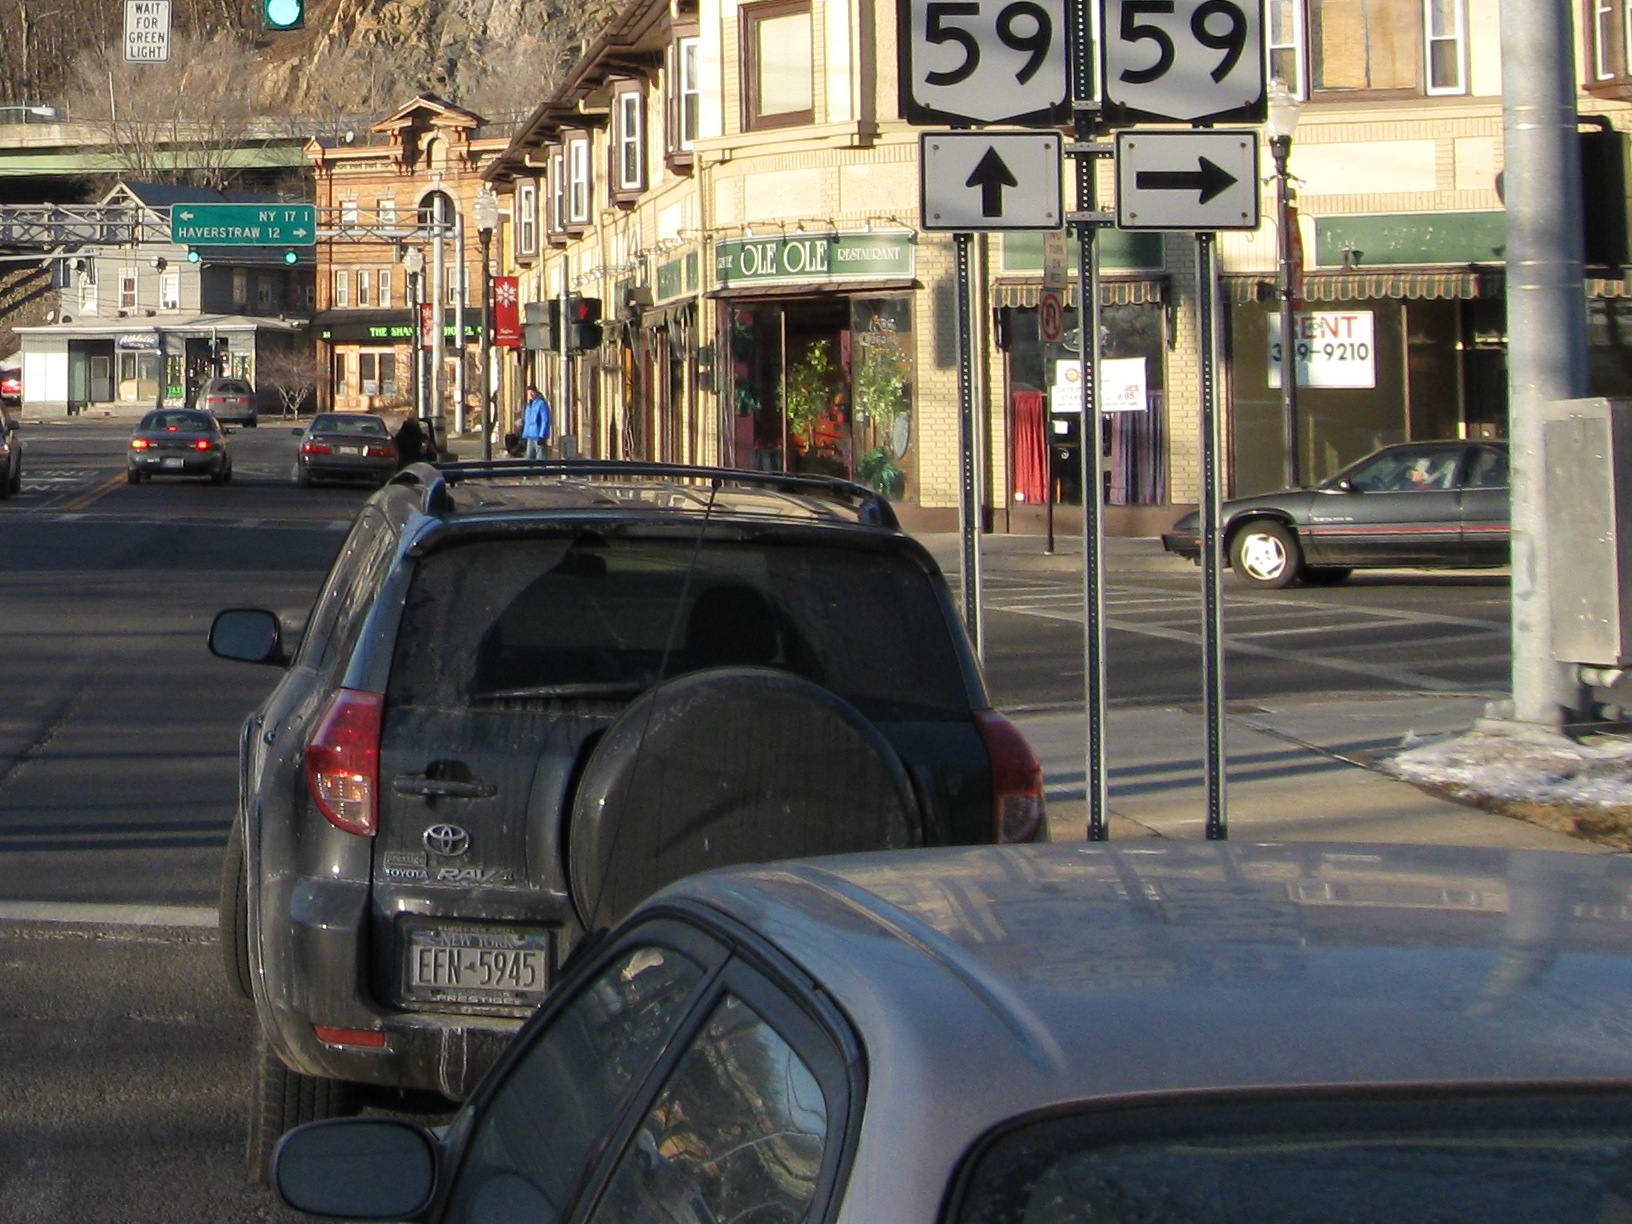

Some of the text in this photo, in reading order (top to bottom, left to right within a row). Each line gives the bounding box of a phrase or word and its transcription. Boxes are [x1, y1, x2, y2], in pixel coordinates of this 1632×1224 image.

[134, 2, 161, 15] WAIT
[136, 17, 159, 30] FOR
[128, 31, 166, 44] GREEN
[924, 0, 1054, 87] 59
[130, 46, 163, 59] LIGHT
[259, 210, 310, 223] NY 17 1
[178, 226, 281, 239] HAVERSTRAW 12
[740, 242, 778, 276] OLE
[783, 238, 829, 274] OLE
[837, 246, 901, 262] RESTAURANT
[369, 327, 388, 337] THE
[443, 326, 475, 336] HOEL
[1294, 315, 1358, 339] ENT
[1272, 342, 1369, 363] 39-9210
[386, 868, 429, 880] TOYOTA
[437, 868, 515, 883] RAV4
[440, 932, 515, 950] NEW YORK
